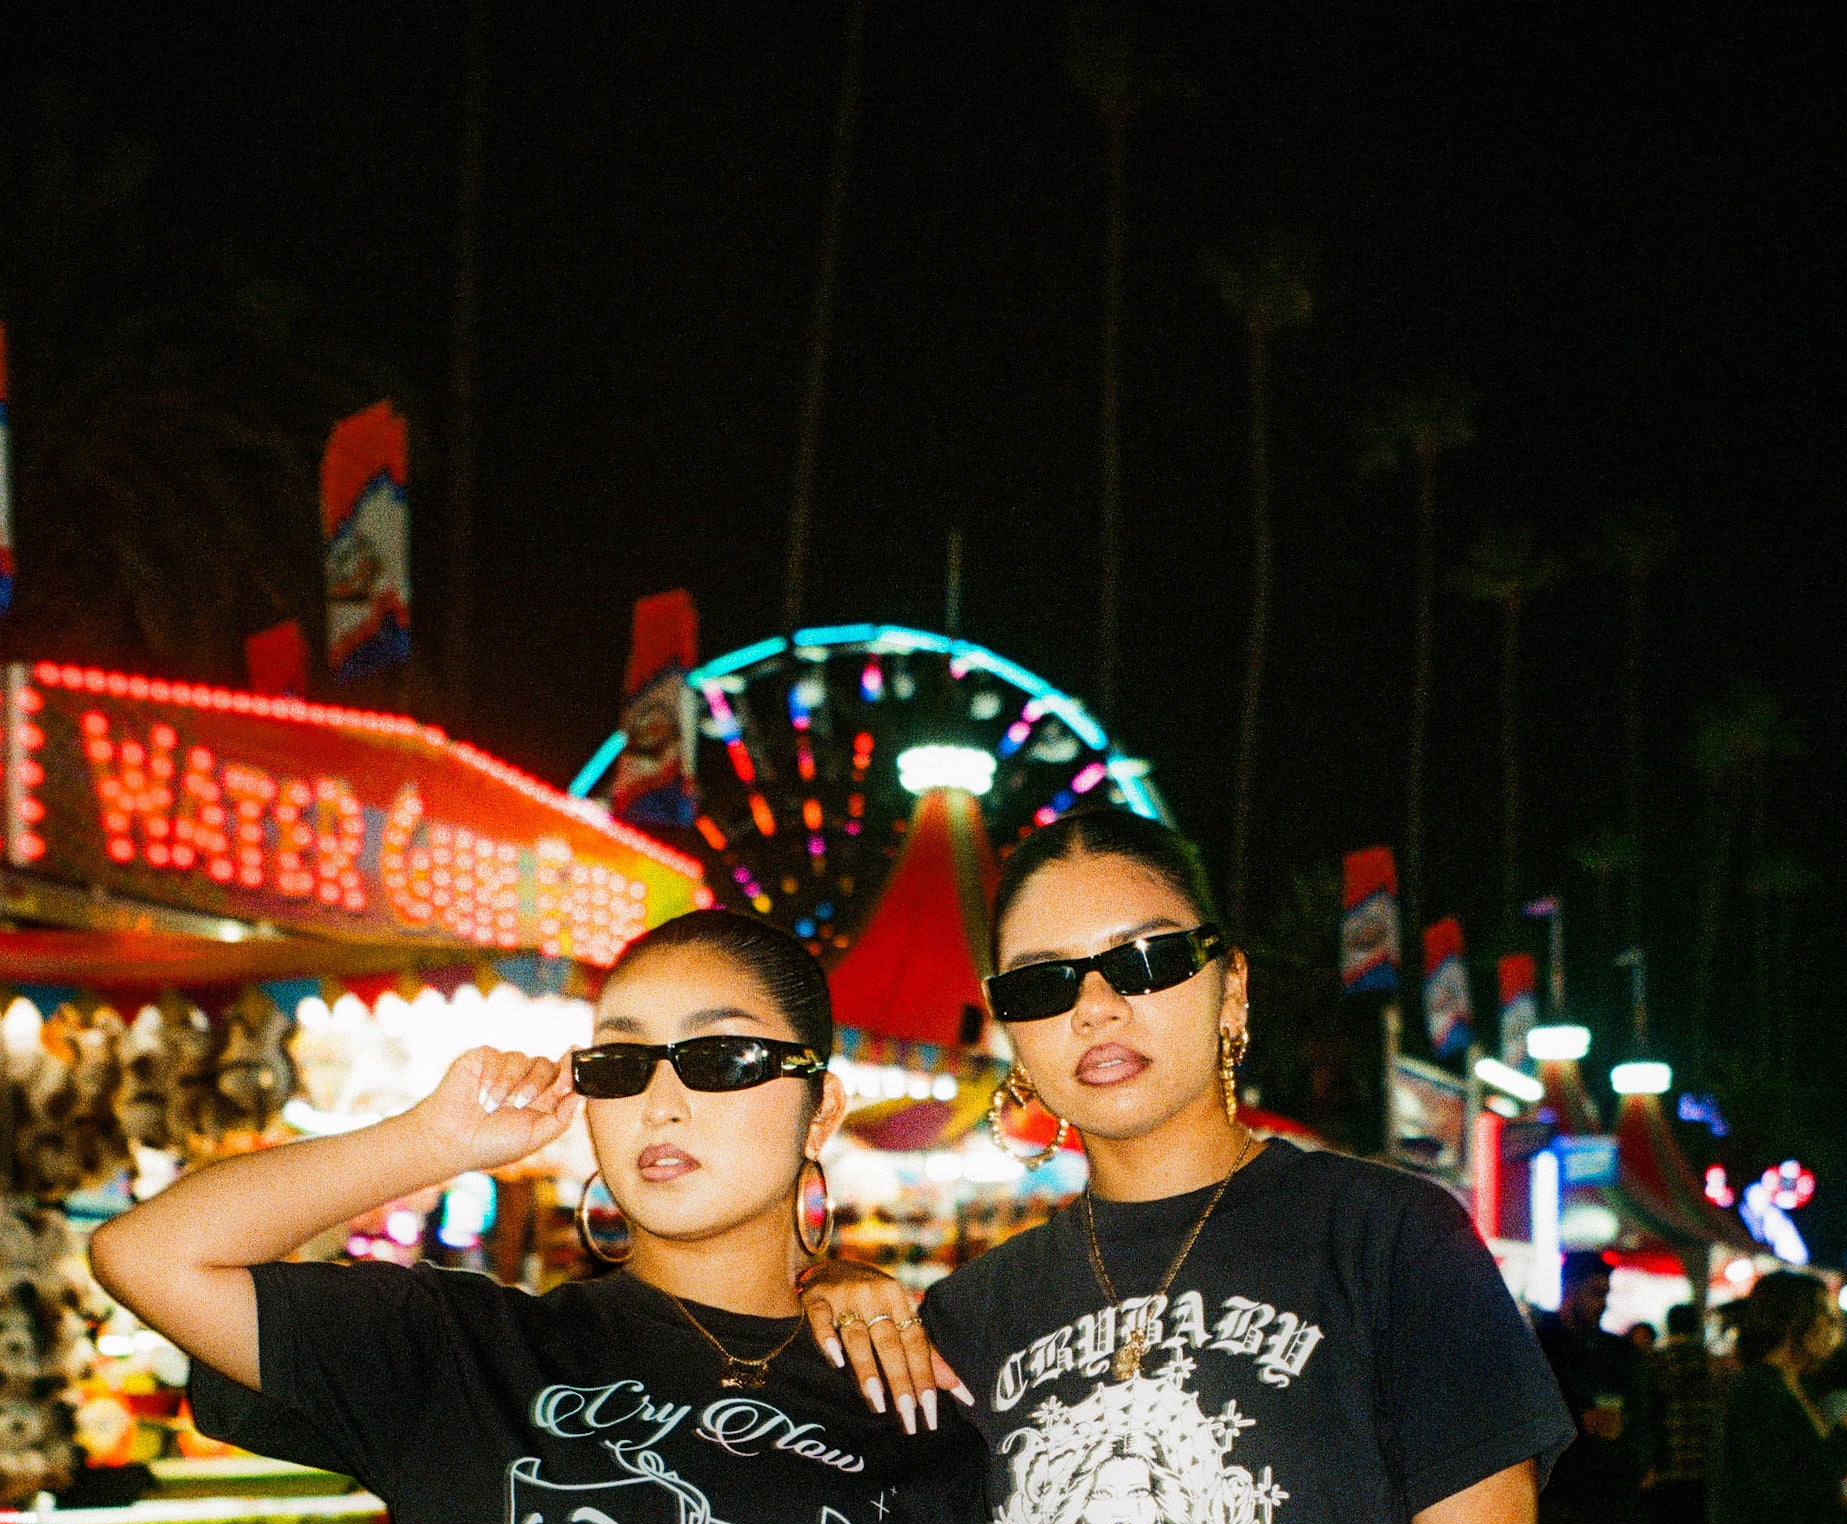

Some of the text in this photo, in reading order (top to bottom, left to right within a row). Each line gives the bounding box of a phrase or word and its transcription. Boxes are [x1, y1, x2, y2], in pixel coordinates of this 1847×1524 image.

[82, 710, 366, 912] WATER
[992, 1291, 1325, 1412] CRYBABY
[532, 1380, 865, 1473] Cry Now
